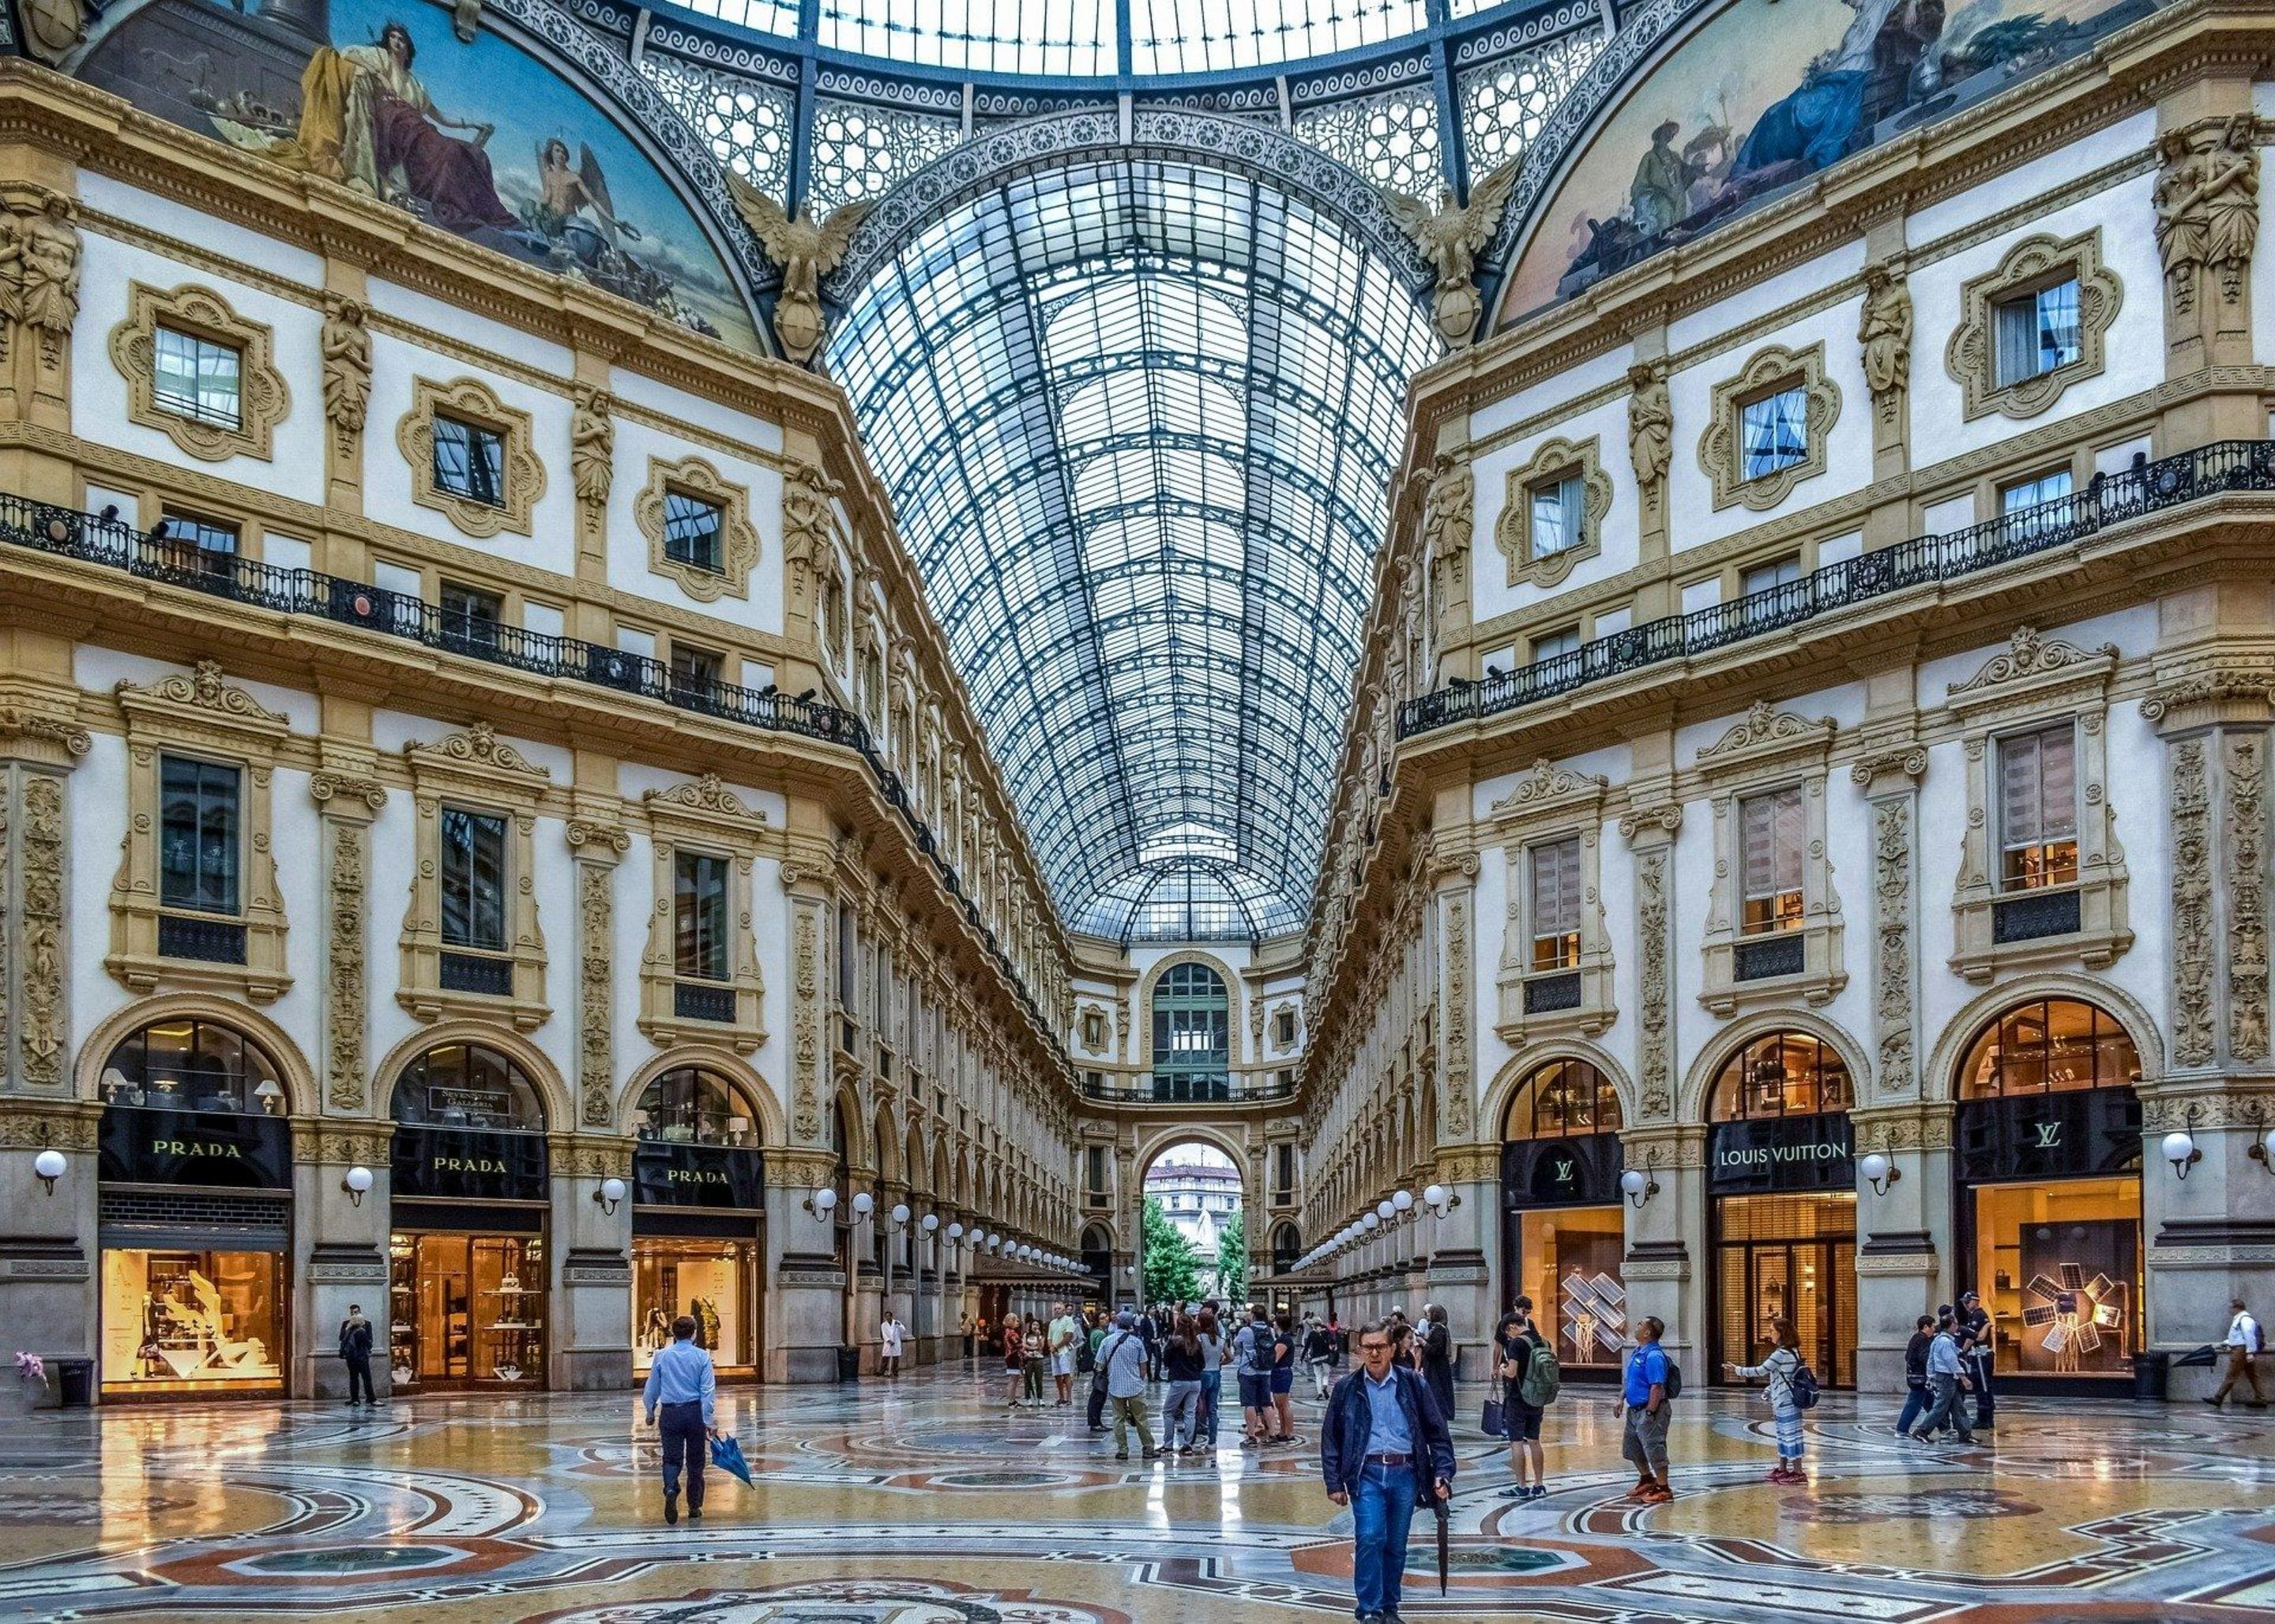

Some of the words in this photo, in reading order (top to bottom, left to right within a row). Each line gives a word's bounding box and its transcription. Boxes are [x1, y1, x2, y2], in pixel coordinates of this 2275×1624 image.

[153, 1140, 241, 1158] PRADA
[1721, 1148, 1768, 1166] LOUIS
[1772, 1142, 1846, 1162] VUITTON
[434, 1157, 507, 1173] PRADA
[667, 1169, 728, 1183] PRADA
